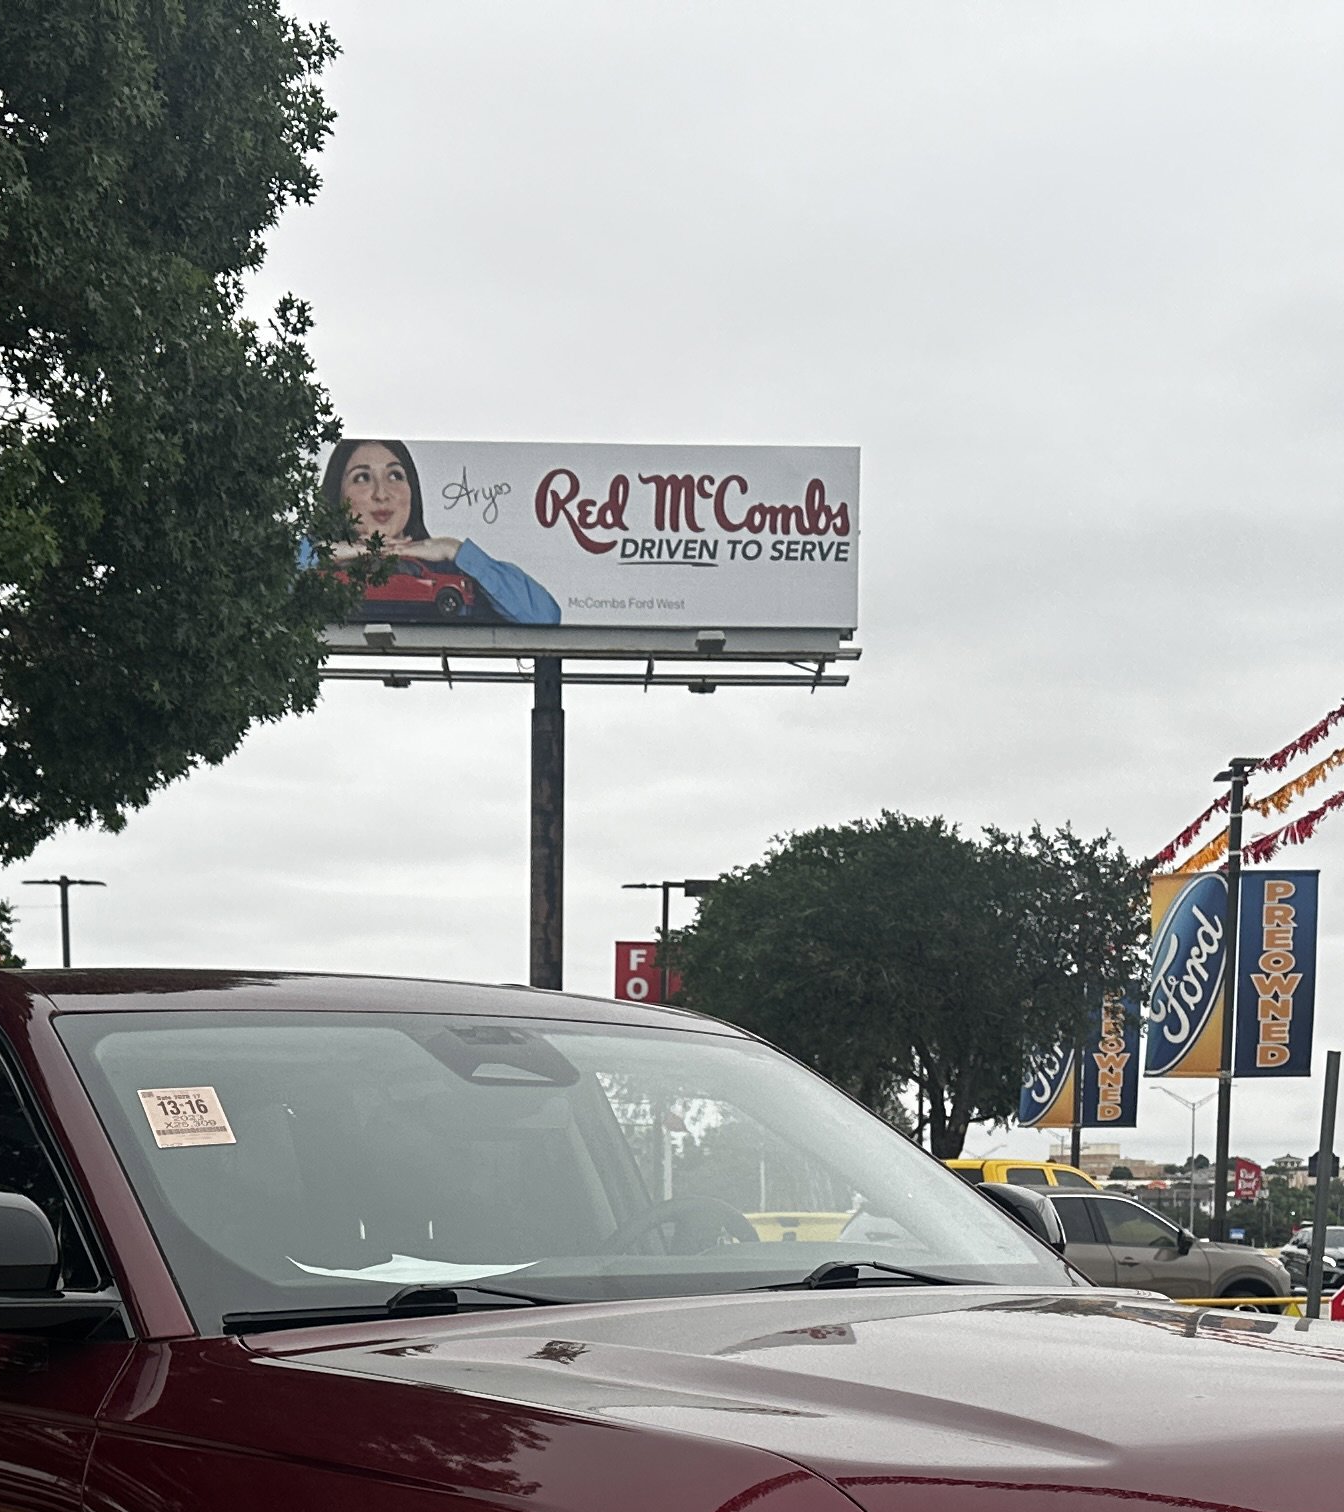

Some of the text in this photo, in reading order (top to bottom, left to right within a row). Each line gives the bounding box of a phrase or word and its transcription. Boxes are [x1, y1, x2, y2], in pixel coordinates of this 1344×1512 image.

[535, 468, 850, 554] Red McCombs
[620, 538, 850, 562] DRIVEN TO SERVE
[568, 597, 686, 611] McCombs Ford West
[626, 949, 650, 1001] FO
[1149, 904, 1225, 1044] Ford
[1251, 880, 1303, 1067] PREOWNED
